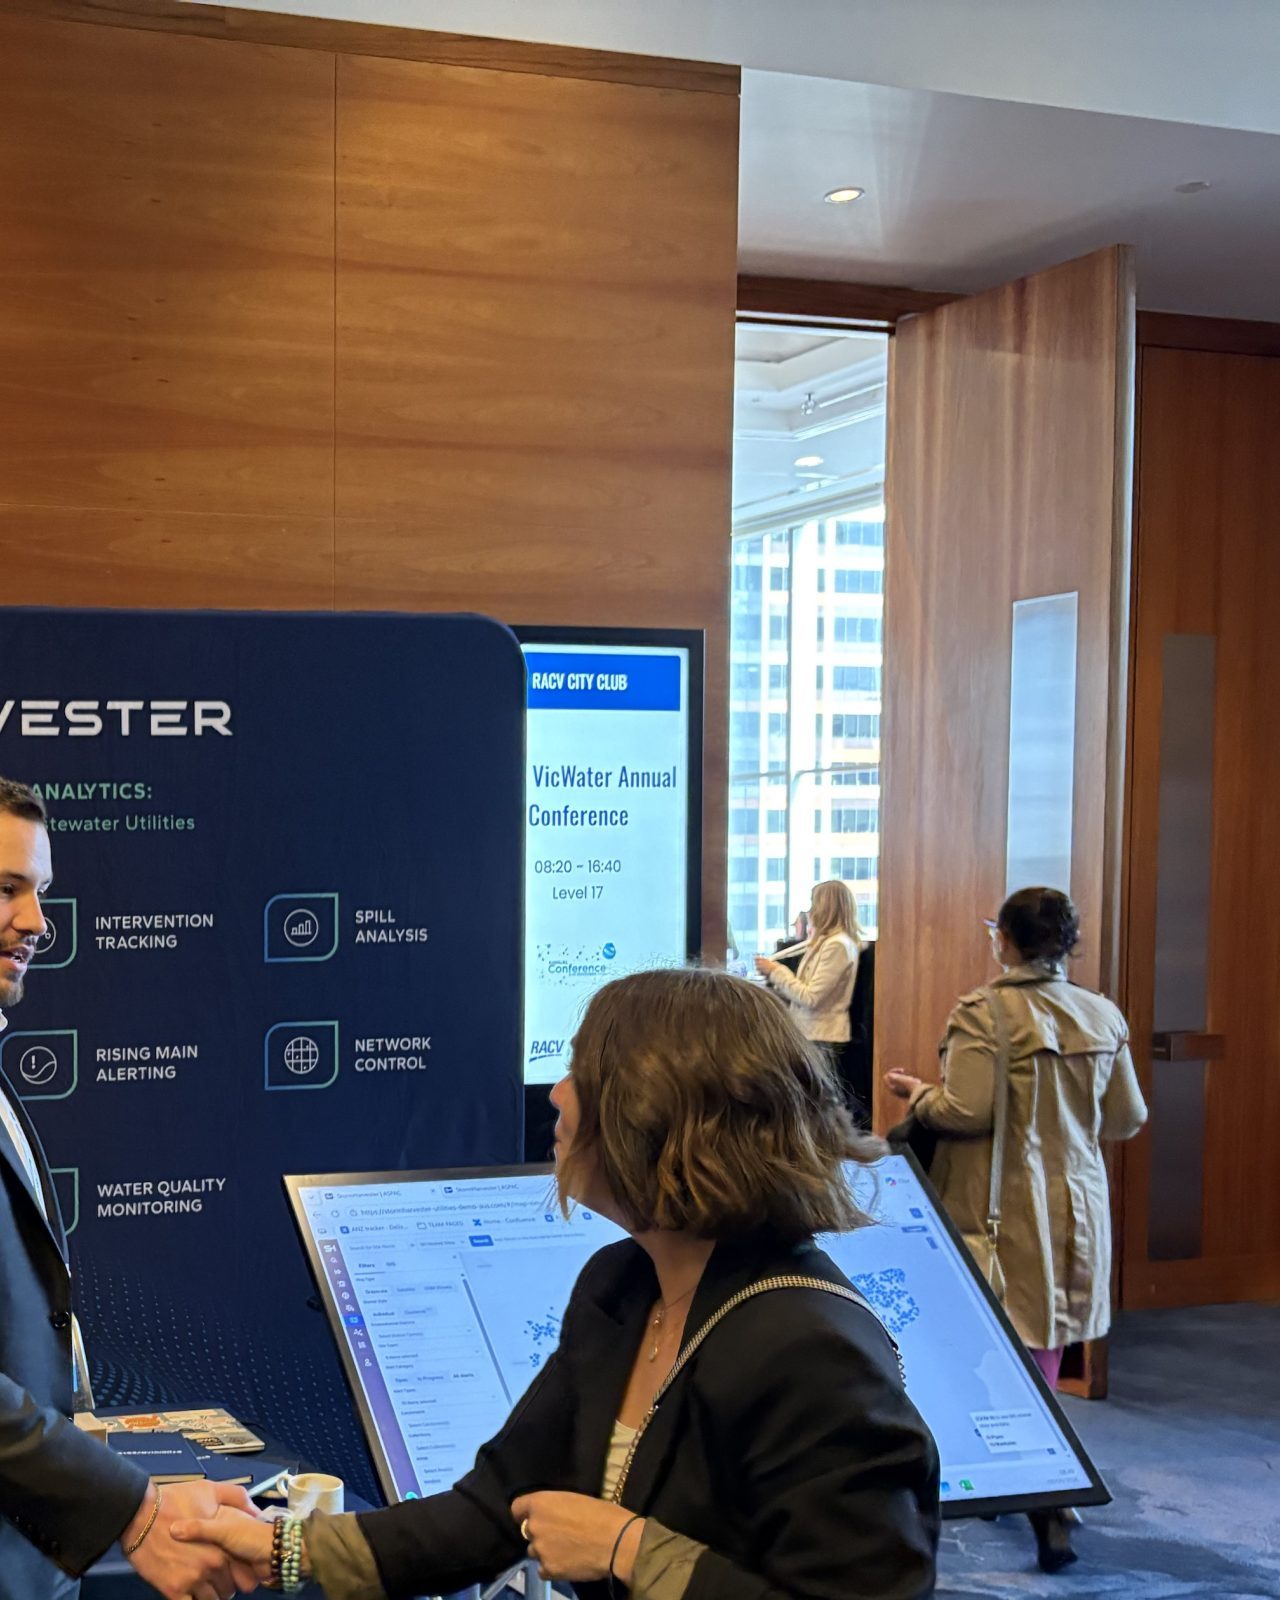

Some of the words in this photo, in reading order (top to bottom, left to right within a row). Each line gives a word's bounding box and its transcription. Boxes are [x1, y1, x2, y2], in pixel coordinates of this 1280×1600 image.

[532, 672, 564, 690] RACV
[567, 672, 594, 691] CITY
[596, 673, 628, 691] CLUB
[533, 764, 613, 788] VicWater
[618, 765, 677, 788] Annual
[32, 782, 152, 800] ANALYTICS:
[125, 814, 195, 831] Utilities
[528, 803, 629, 827] Conference
[534, 859, 573, 874] 08:20
[587, 859, 622, 873] 16:40
[552, 886, 587, 900] Level
[590, 886, 604, 900] 17
[95, 913, 214, 930] INTERVENTION
[355, 909, 396, 924] SPILL
[95, 934, 178, 950] TRACKING
[355, 928, 428, 943] ANALYSIS
[355, 1036, 431, 1053] NETWORK
[531, 1039, 565, 1055] RACV
[96, 1046, 151, 1062] RISING
[155, 1045, 198, 1060] MAIN
[355, 1055, 427, 1072] CONTROL
[95, 1065, 177, 1082] ALERTING
[96, 1181, 153, 1198] WATER
[157, 1178, 226, 1196] QUALITY
[97, 1199, 203, 1218] MONITORING
